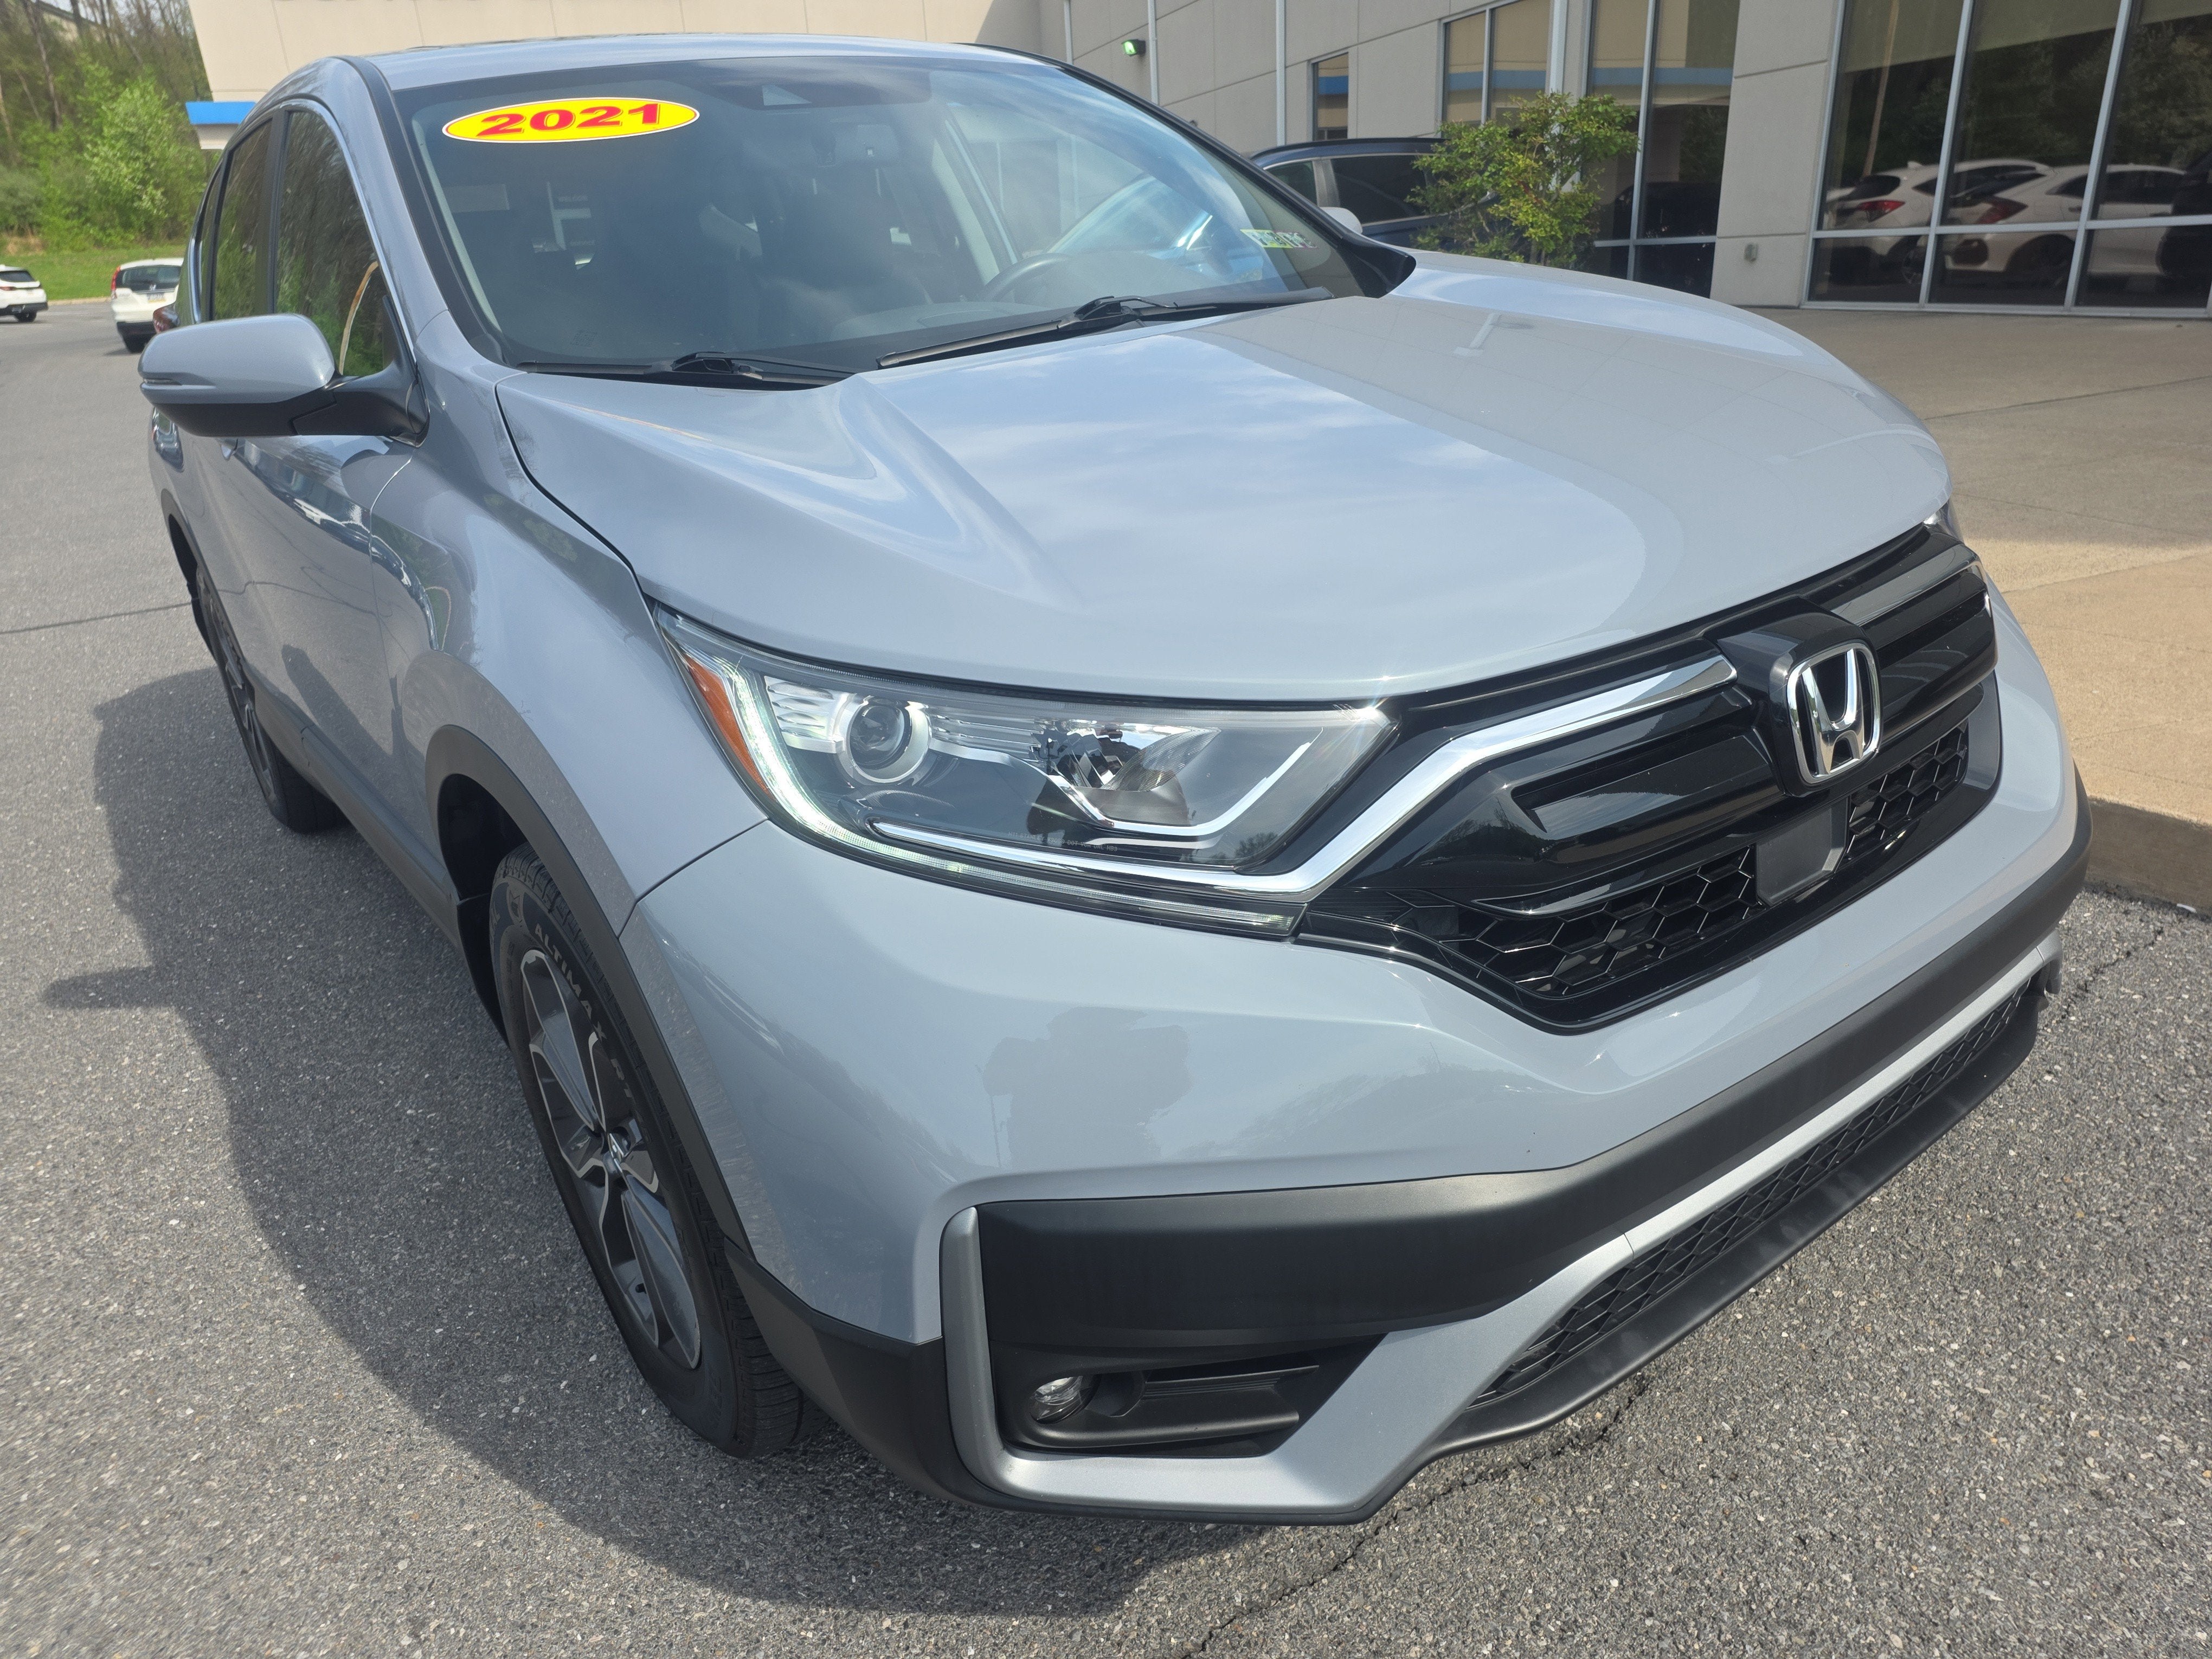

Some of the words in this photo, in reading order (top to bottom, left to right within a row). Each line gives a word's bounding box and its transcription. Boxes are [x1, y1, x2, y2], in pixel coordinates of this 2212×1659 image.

[475, 103, 661, 137] 2021
[1020, 833, 1045, 841] STANLEY
[535, 923, 607, 1042] ALTIMAX
